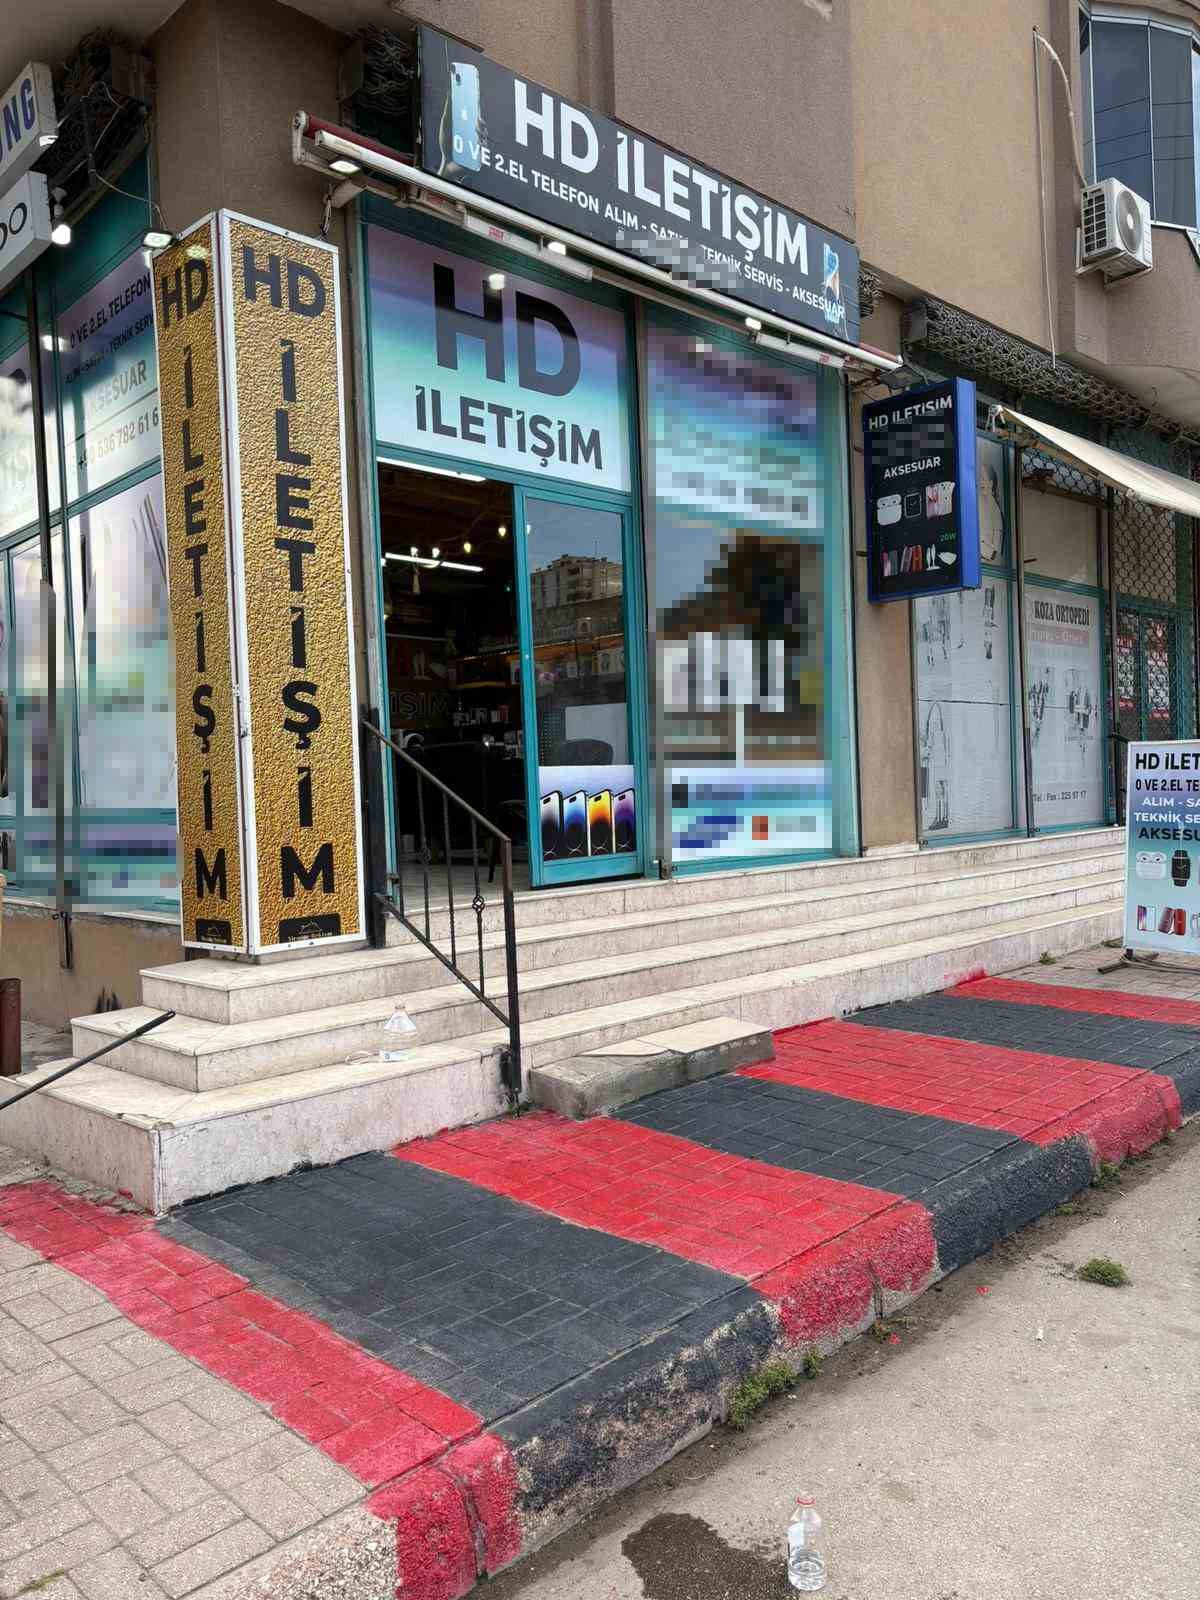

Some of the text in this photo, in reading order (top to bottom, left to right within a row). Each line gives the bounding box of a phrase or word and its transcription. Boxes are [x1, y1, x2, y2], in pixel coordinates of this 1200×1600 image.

[0, 78, 36, 164] NG
[514, 79, 808, 276] HD İLETİŞİM
[468, 142, 491, 166] VE
[494, 154, 528, 184] 2.EL
[531, 169, 599, 215] TELEFON
[604, 203, 639, 231] ALIM
[744, 264, 784, 293] SERVİS
[792, 286, 846, 319] AKSESUAR
[77, 322, 88, 345] VE
[108, 273, 150, 325] TELEFON
[161, 258, 208, 328] HD
[243, 245, 327, 318] HD
[433, 262, 582, 397] HD
[415, 384, 603, 471] İLETİŞİM
[868, 414, 889, 431] HD
[884, 456, 942, 480] AKSESUAR
[1135, 753, 1160, 770] HD
[1135, 779, 1142, 791] 0
[1144, 779, 1158, 791] VE
[1160, 779, 1183, 792] 2.EL
[1134, 810, 1181, 823] TEKNİK
[1142, 798, 1174, 807] ALIM
